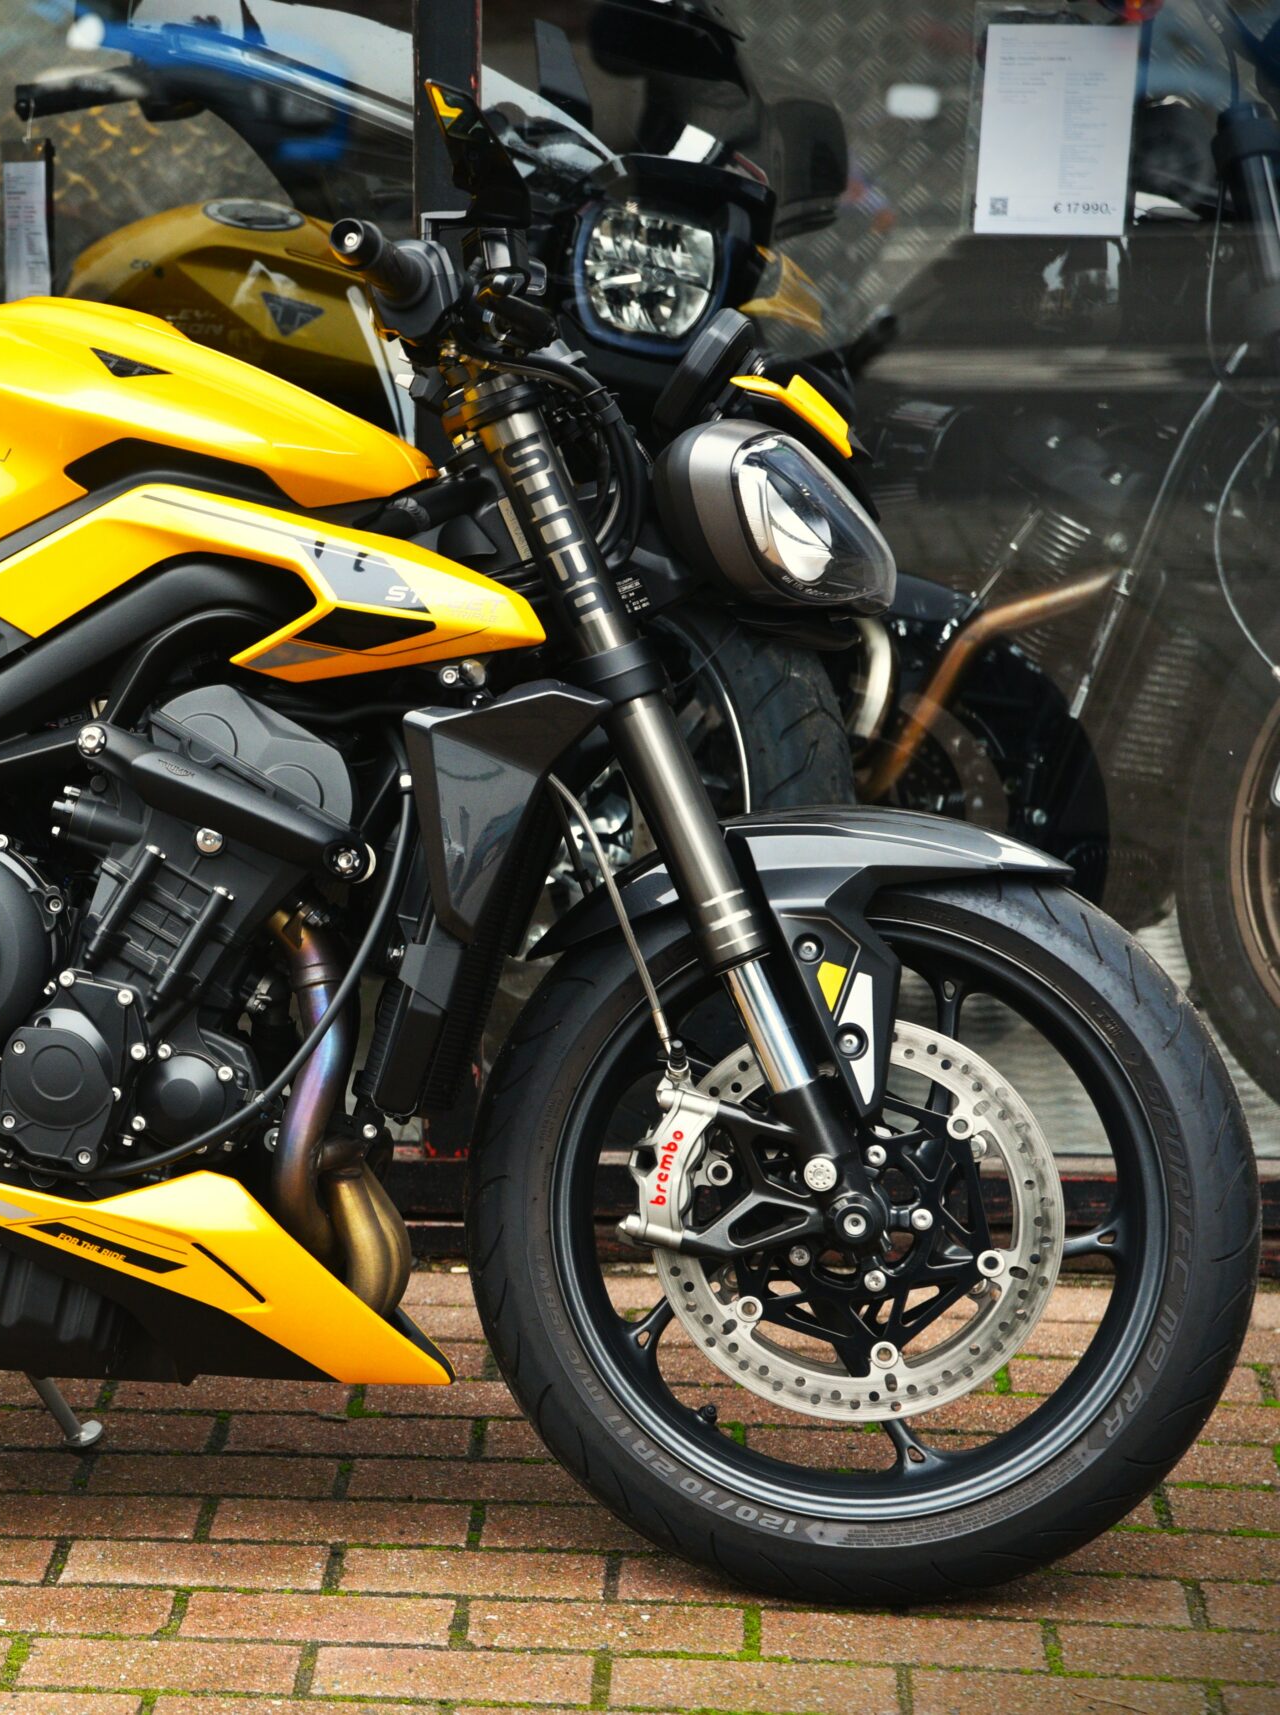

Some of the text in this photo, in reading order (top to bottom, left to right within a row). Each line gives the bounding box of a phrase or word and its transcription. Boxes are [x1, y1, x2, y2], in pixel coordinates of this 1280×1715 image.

[385, 585, 507, 612] STEET
[649, 1130, 684, 1206] brembo
[57, 1232, 127, 1261] FOR THE RIDE
[1101, 1375, 1145, 1438] RR
[677, 1474, 800, 1536] 120/70
